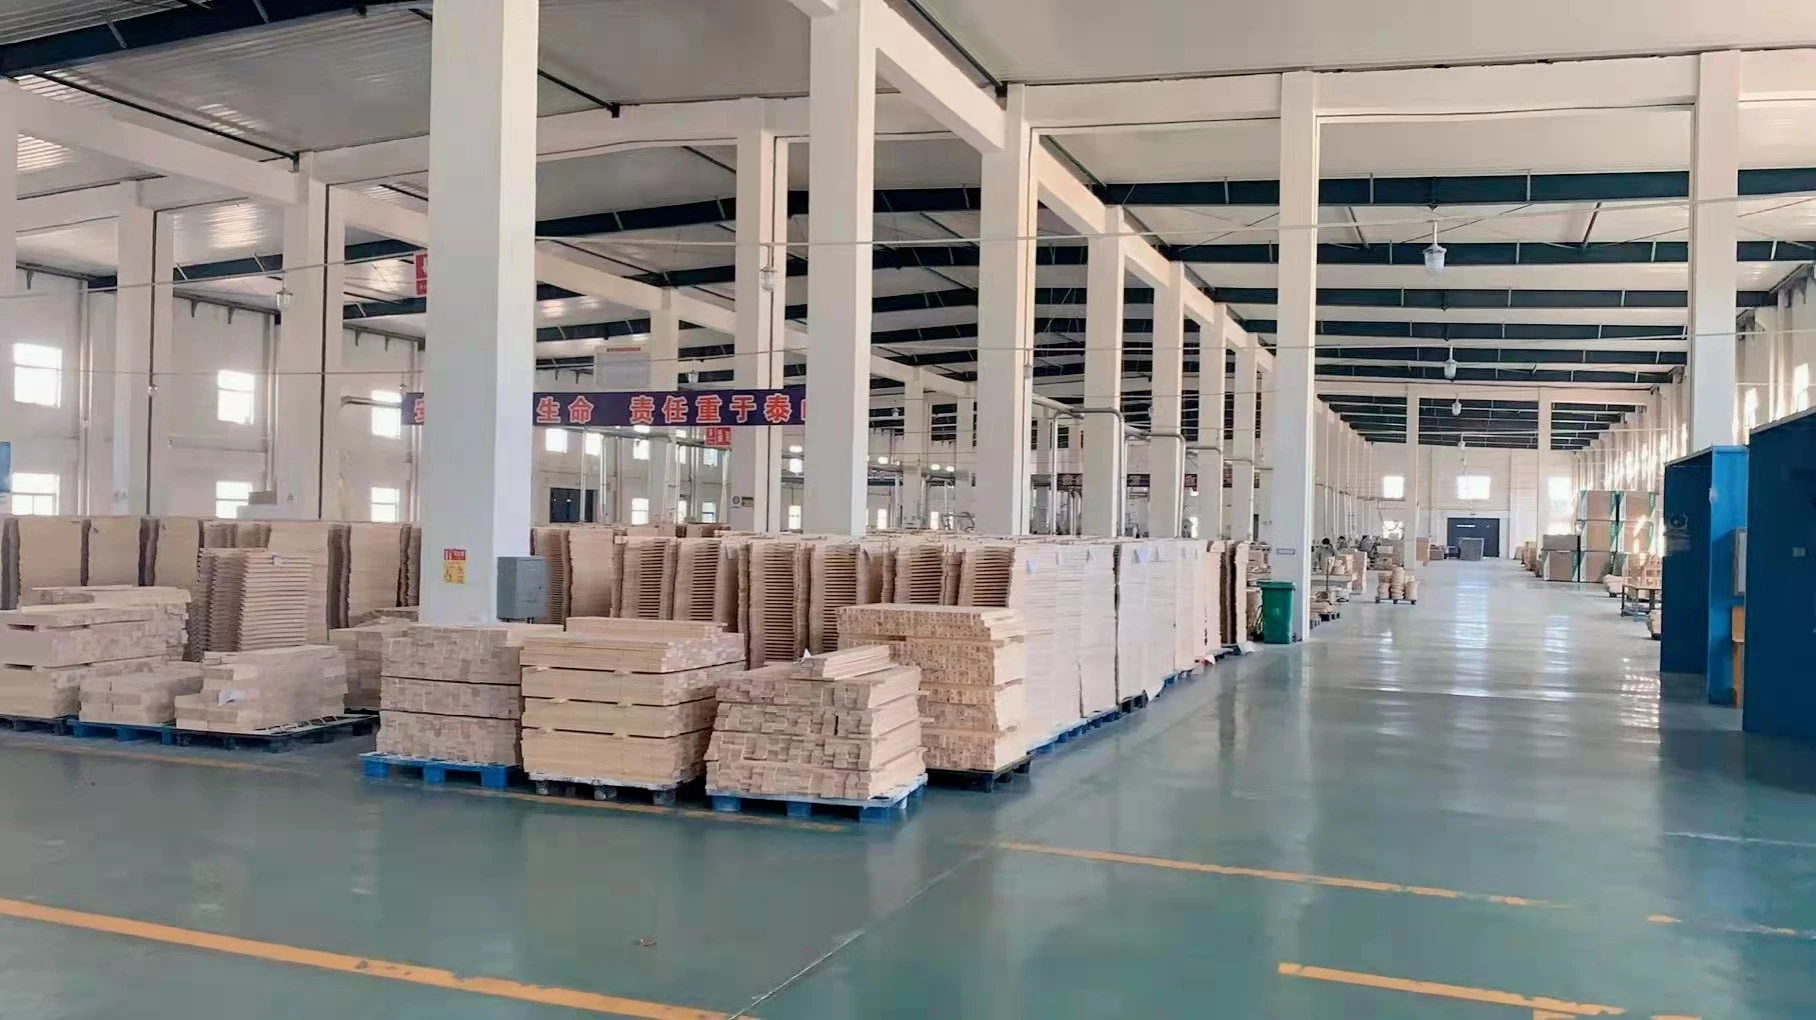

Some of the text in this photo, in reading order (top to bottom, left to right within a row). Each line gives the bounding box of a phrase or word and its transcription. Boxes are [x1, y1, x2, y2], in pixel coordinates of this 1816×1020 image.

[629, 393, 806, 424] 责任重于泰
